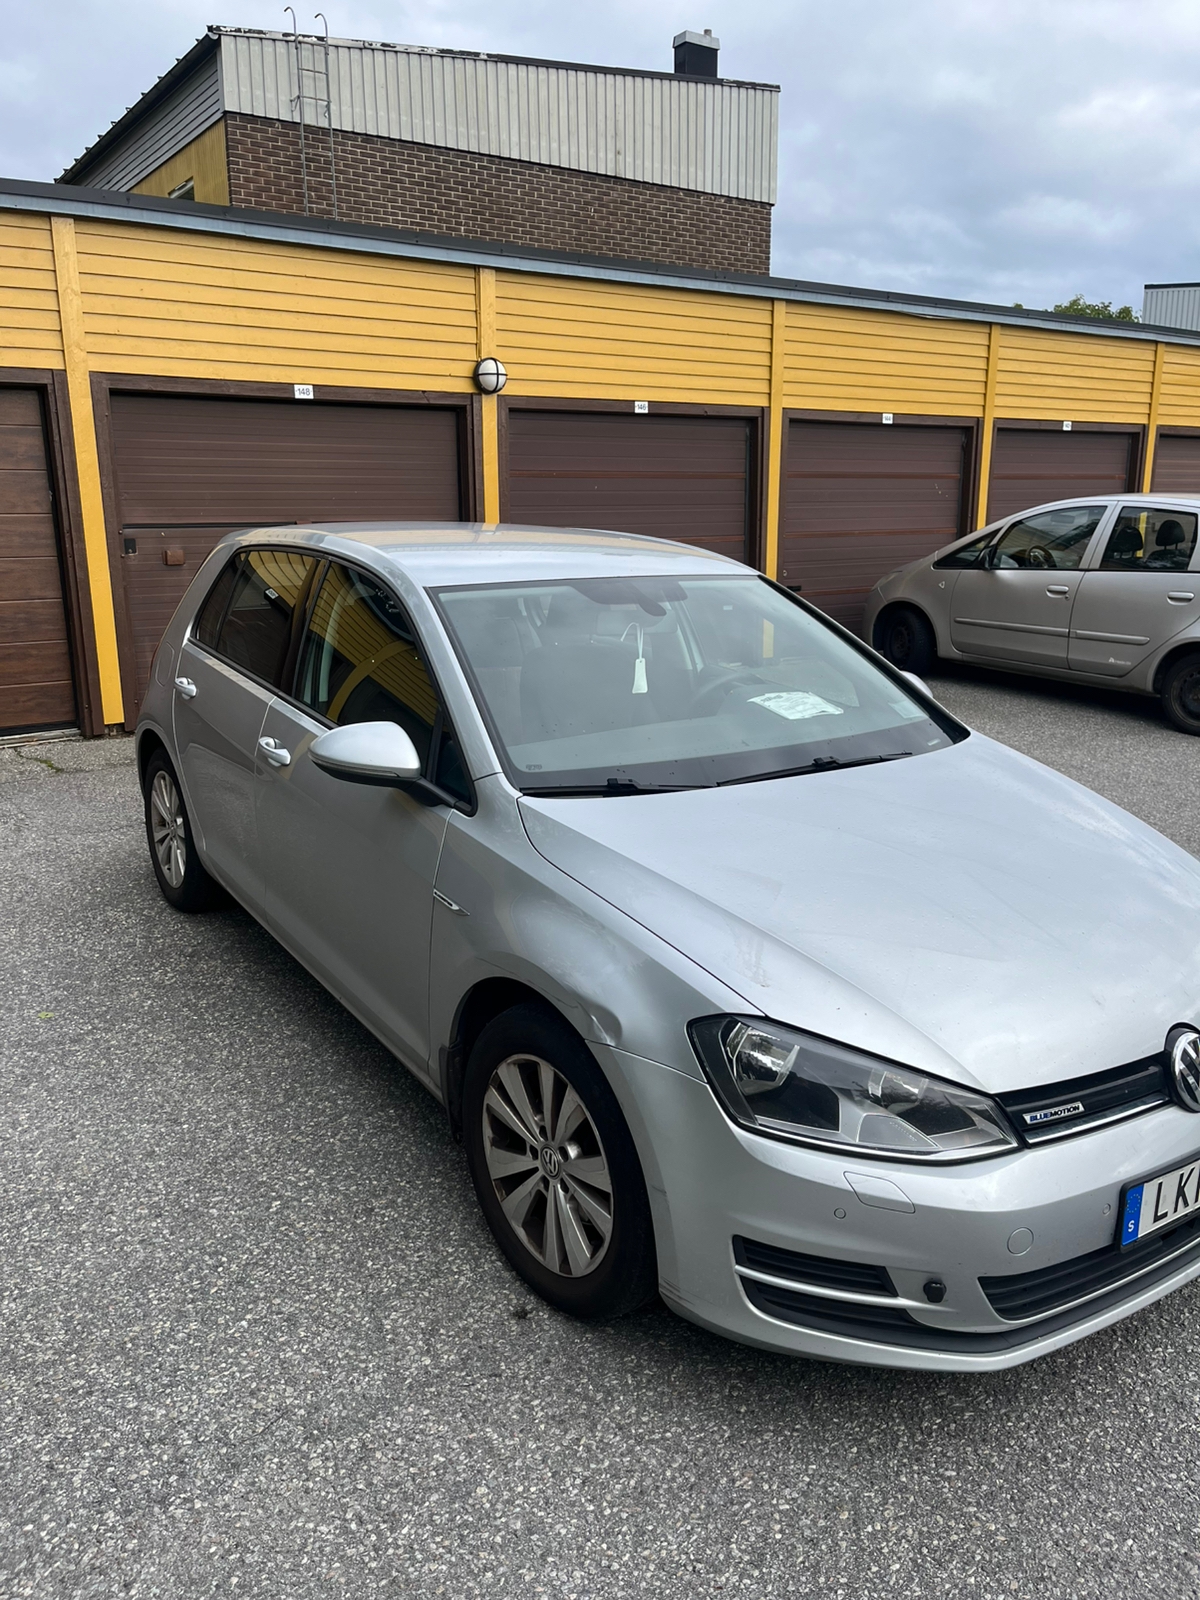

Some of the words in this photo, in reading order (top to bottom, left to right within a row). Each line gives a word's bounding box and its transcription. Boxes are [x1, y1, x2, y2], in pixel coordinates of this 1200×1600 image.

[297, 388, 311, 396] 148
[1029, 1104, 1080, 1122] BLUEMOTION
[1152, 1166, 1200, 1224] LK
[1127, 1219, 1135, 1233] S
